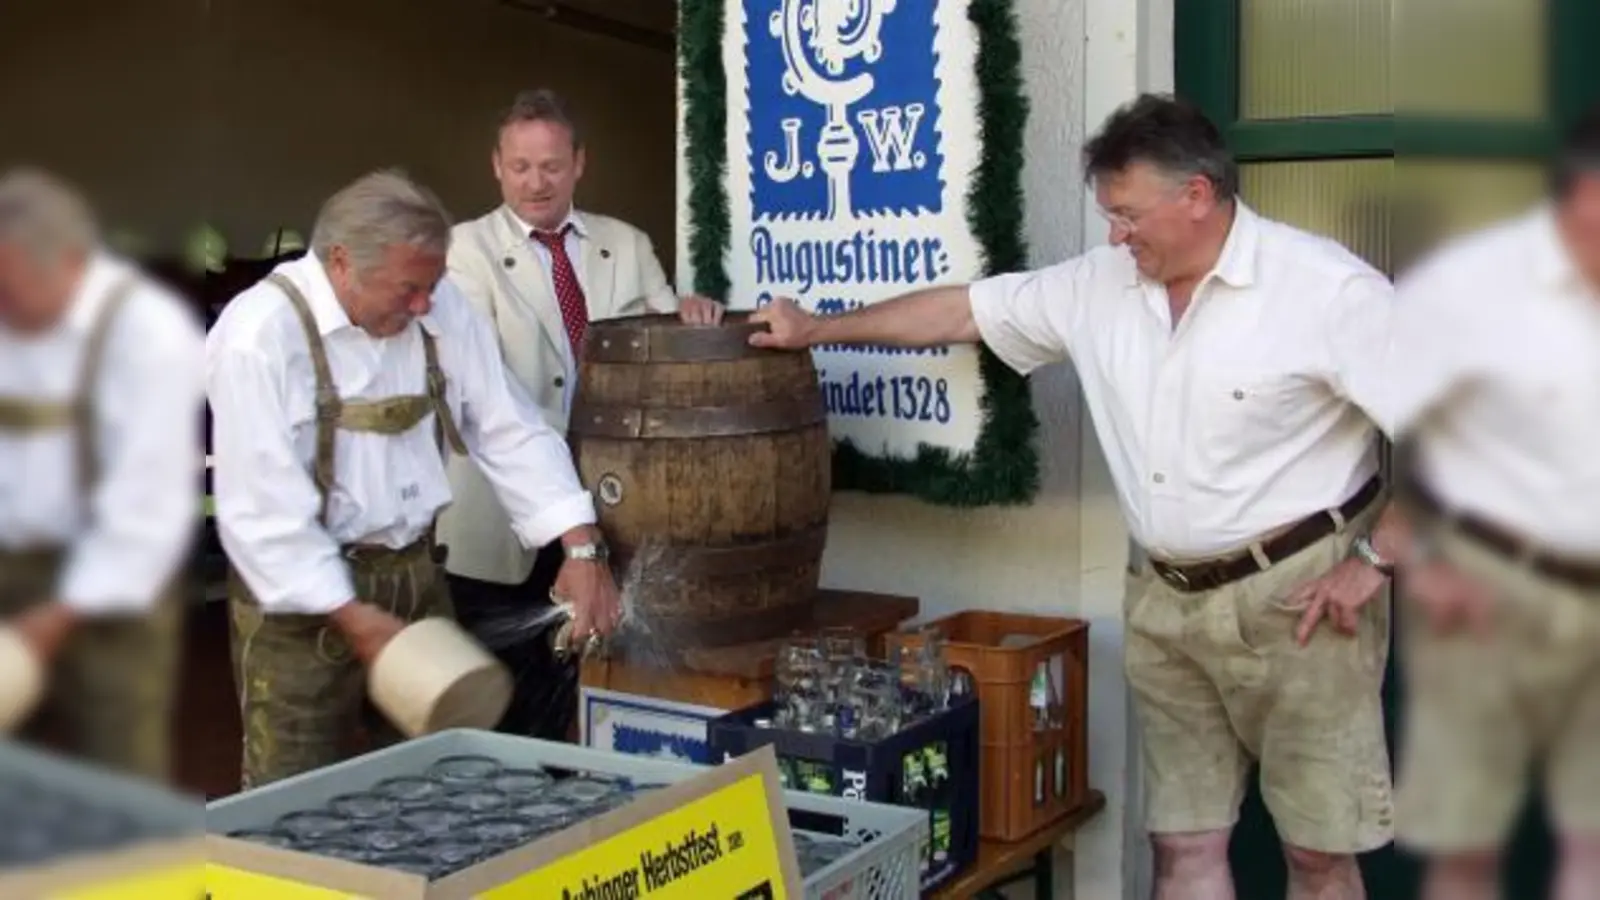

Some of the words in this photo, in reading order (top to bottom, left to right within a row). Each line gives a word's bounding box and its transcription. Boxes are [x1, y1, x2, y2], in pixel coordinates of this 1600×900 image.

[764, 118, 815, 182] J.
[858, 103, 926, 173] W.
[890, 376, 951, 423] 1328
[639, 821, 723, 893] Herbstfest
